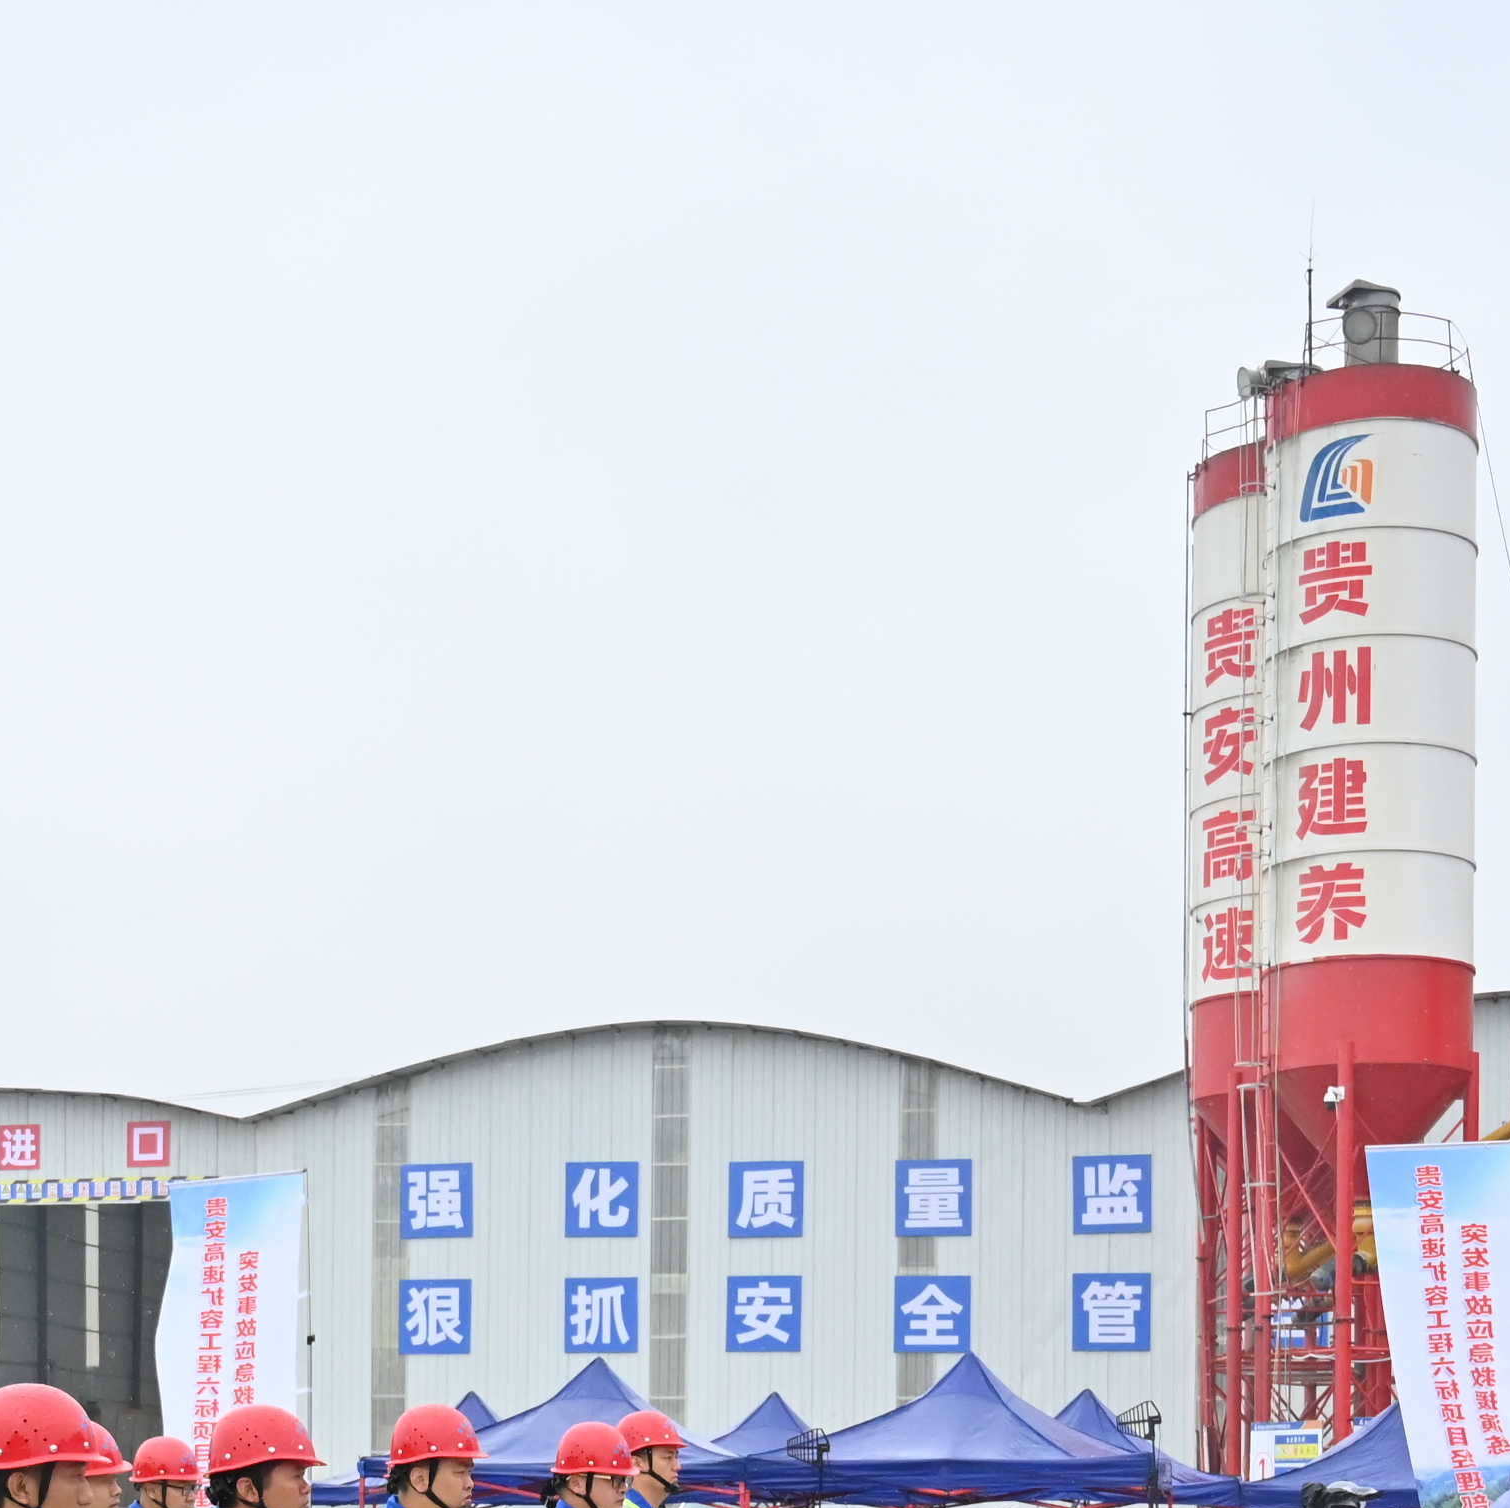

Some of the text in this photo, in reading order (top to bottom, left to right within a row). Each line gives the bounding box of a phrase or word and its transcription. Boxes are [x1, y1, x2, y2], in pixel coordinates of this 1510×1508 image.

[1296, 540, 1373, 948] 贵州建养
[1201, 606, 1260, 985] 贵安高速
[1, 1126, 164, 1167] 进口
[407, 1164, 1144, 1230] 强化质量监
[405, 1281, 1143, 1347] 狠抓安全管
